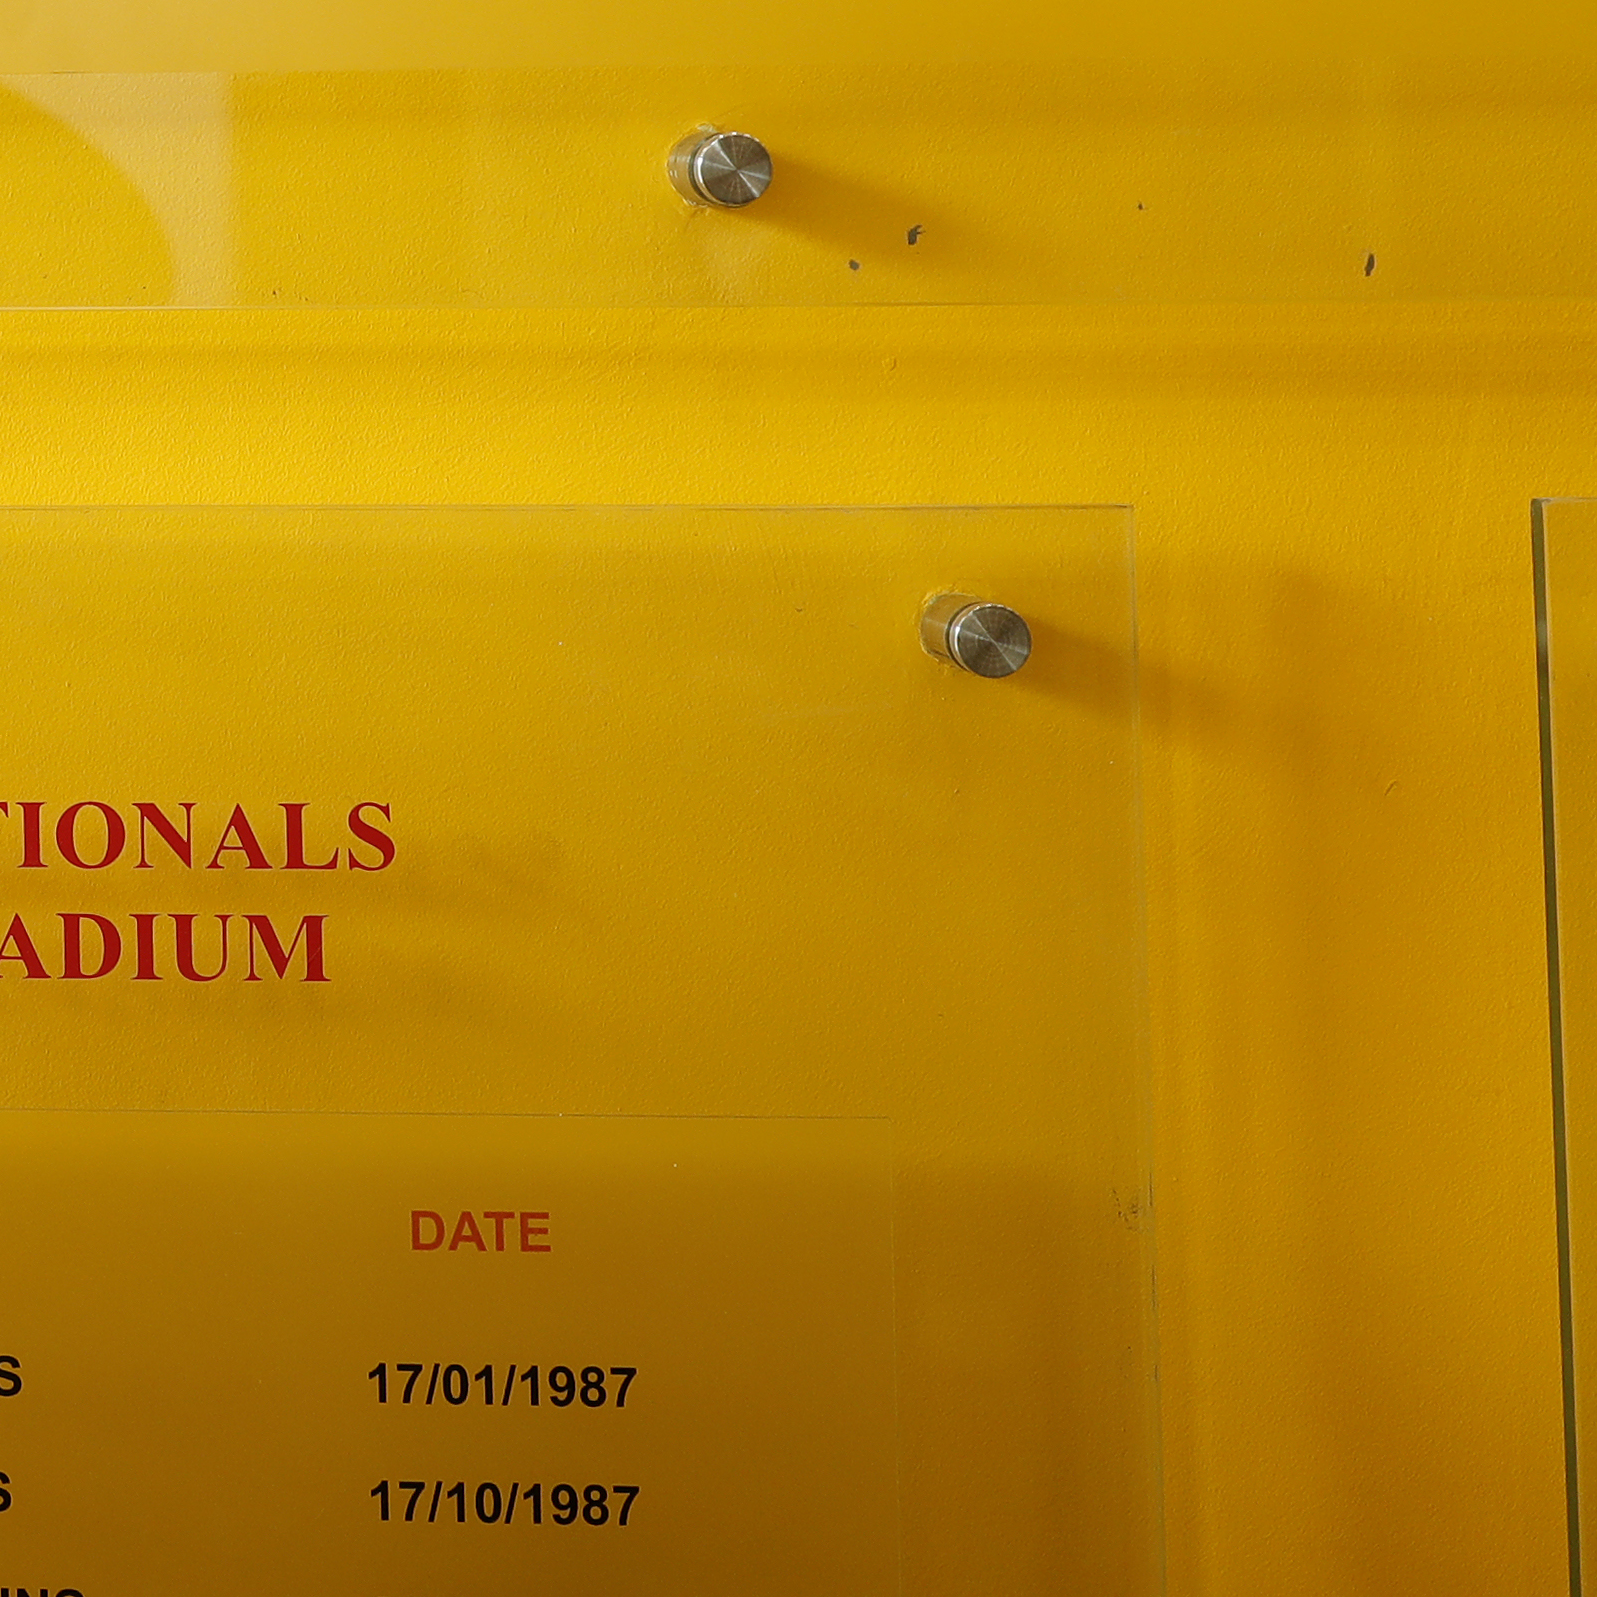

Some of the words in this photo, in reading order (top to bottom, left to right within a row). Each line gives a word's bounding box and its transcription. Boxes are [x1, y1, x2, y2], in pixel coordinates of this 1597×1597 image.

[411, 1210, 552, 1253] DATE
[368, 1362, 638, 1408] 17/01/1987
[370, 1479, 640, 1527] 17/10/1987
